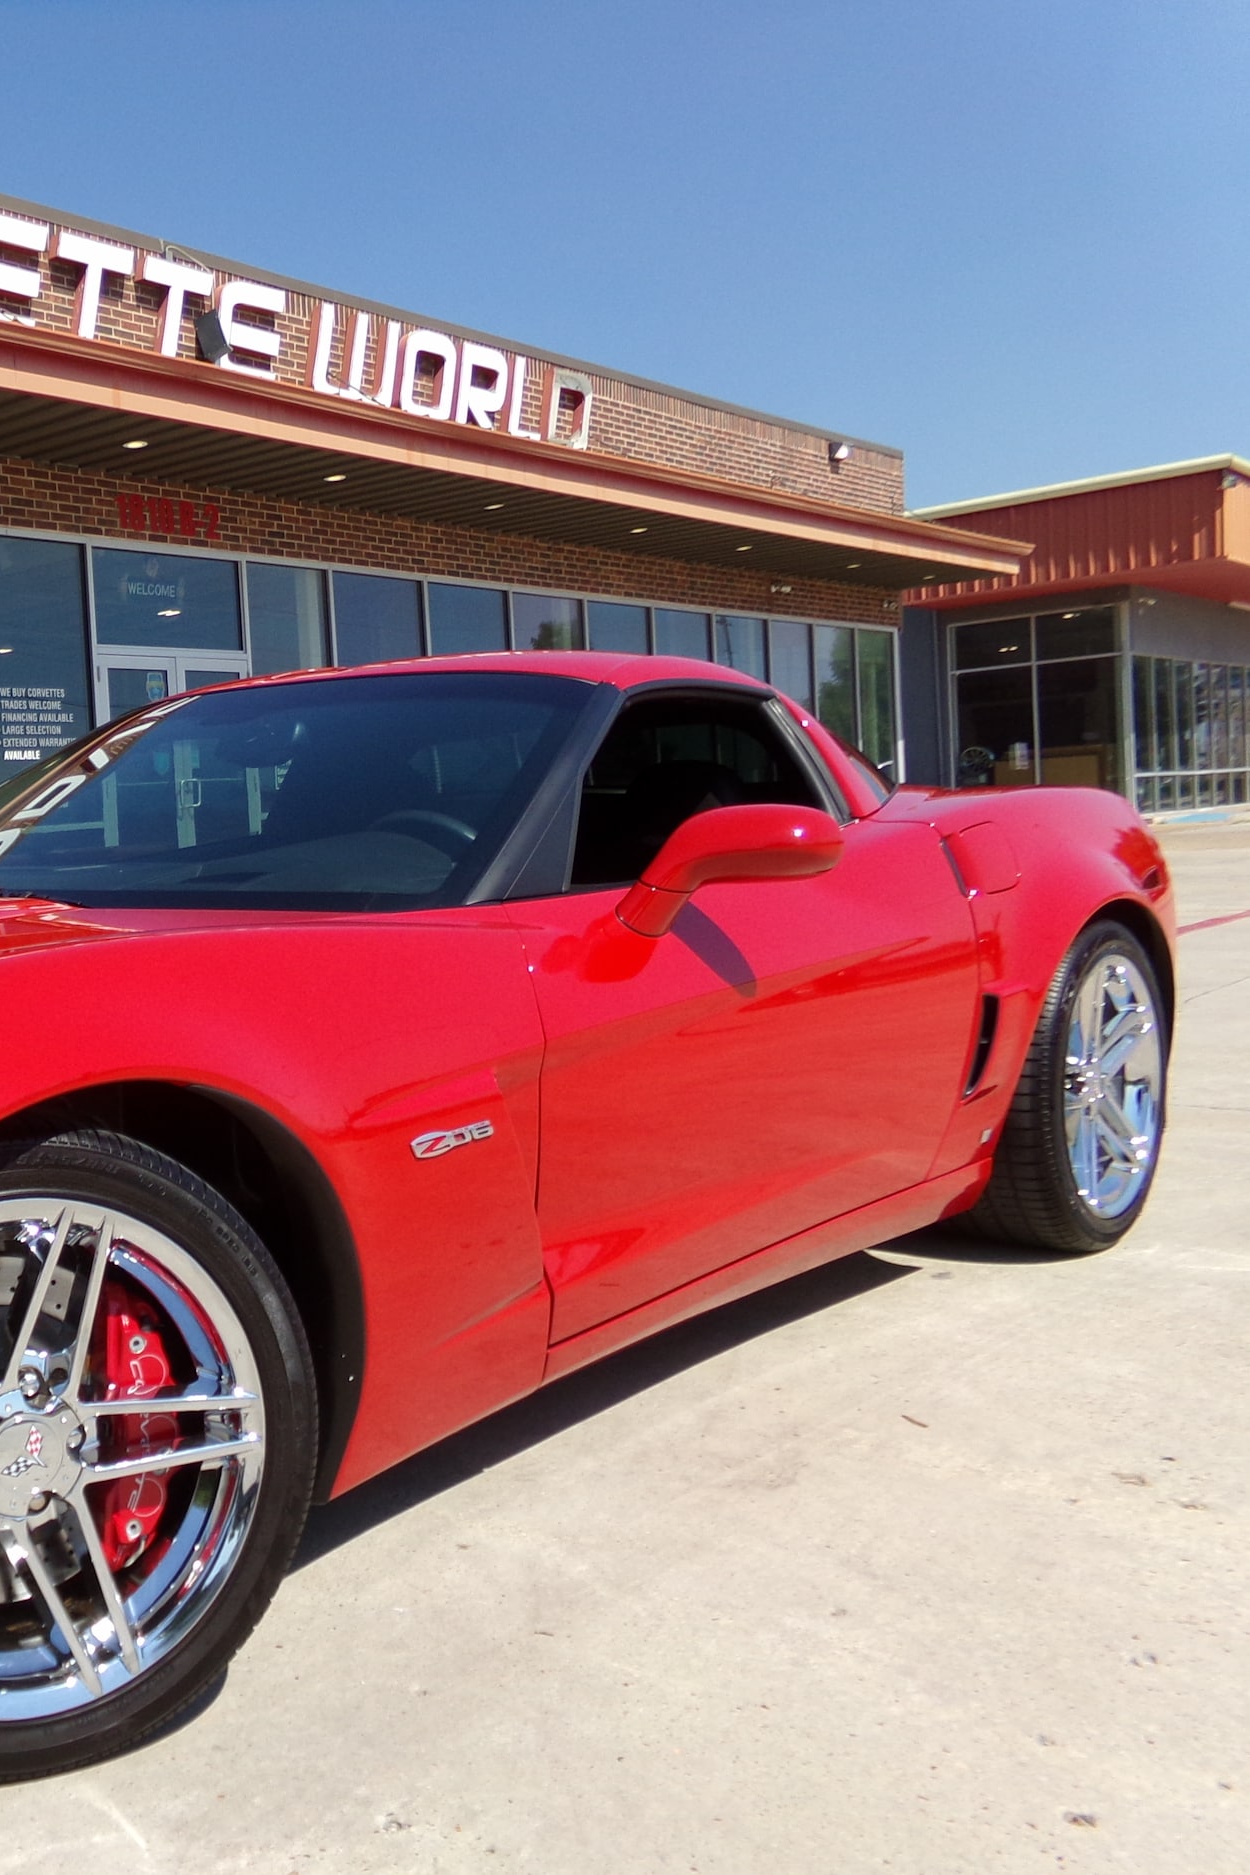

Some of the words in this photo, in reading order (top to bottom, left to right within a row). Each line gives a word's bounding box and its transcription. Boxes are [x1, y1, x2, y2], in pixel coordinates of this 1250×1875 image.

[309, 301, 593, 450] WORLD
[127, 581, 176, 598] WELCOME
[0, 688, 11, 697] WE
[12, 688, 26, 697] BUY
[27, 688, 65, 698] CORVETTES
[1, 700, 27, 710] TRADES
[28, 701, 62, 711] WELCOME
[1, 713, 38, 723] FINANCING
[39, 713, 74, 722] AVAILABLE
[2, 726, 24, 735] LARGE
[26, 726, 62, 735] SELECTION
[2, 738, 38, 748] EXTENDED
[4, 750, 41, 760] AVAILABLE
[410, 1119, 494, 1159] Z06
